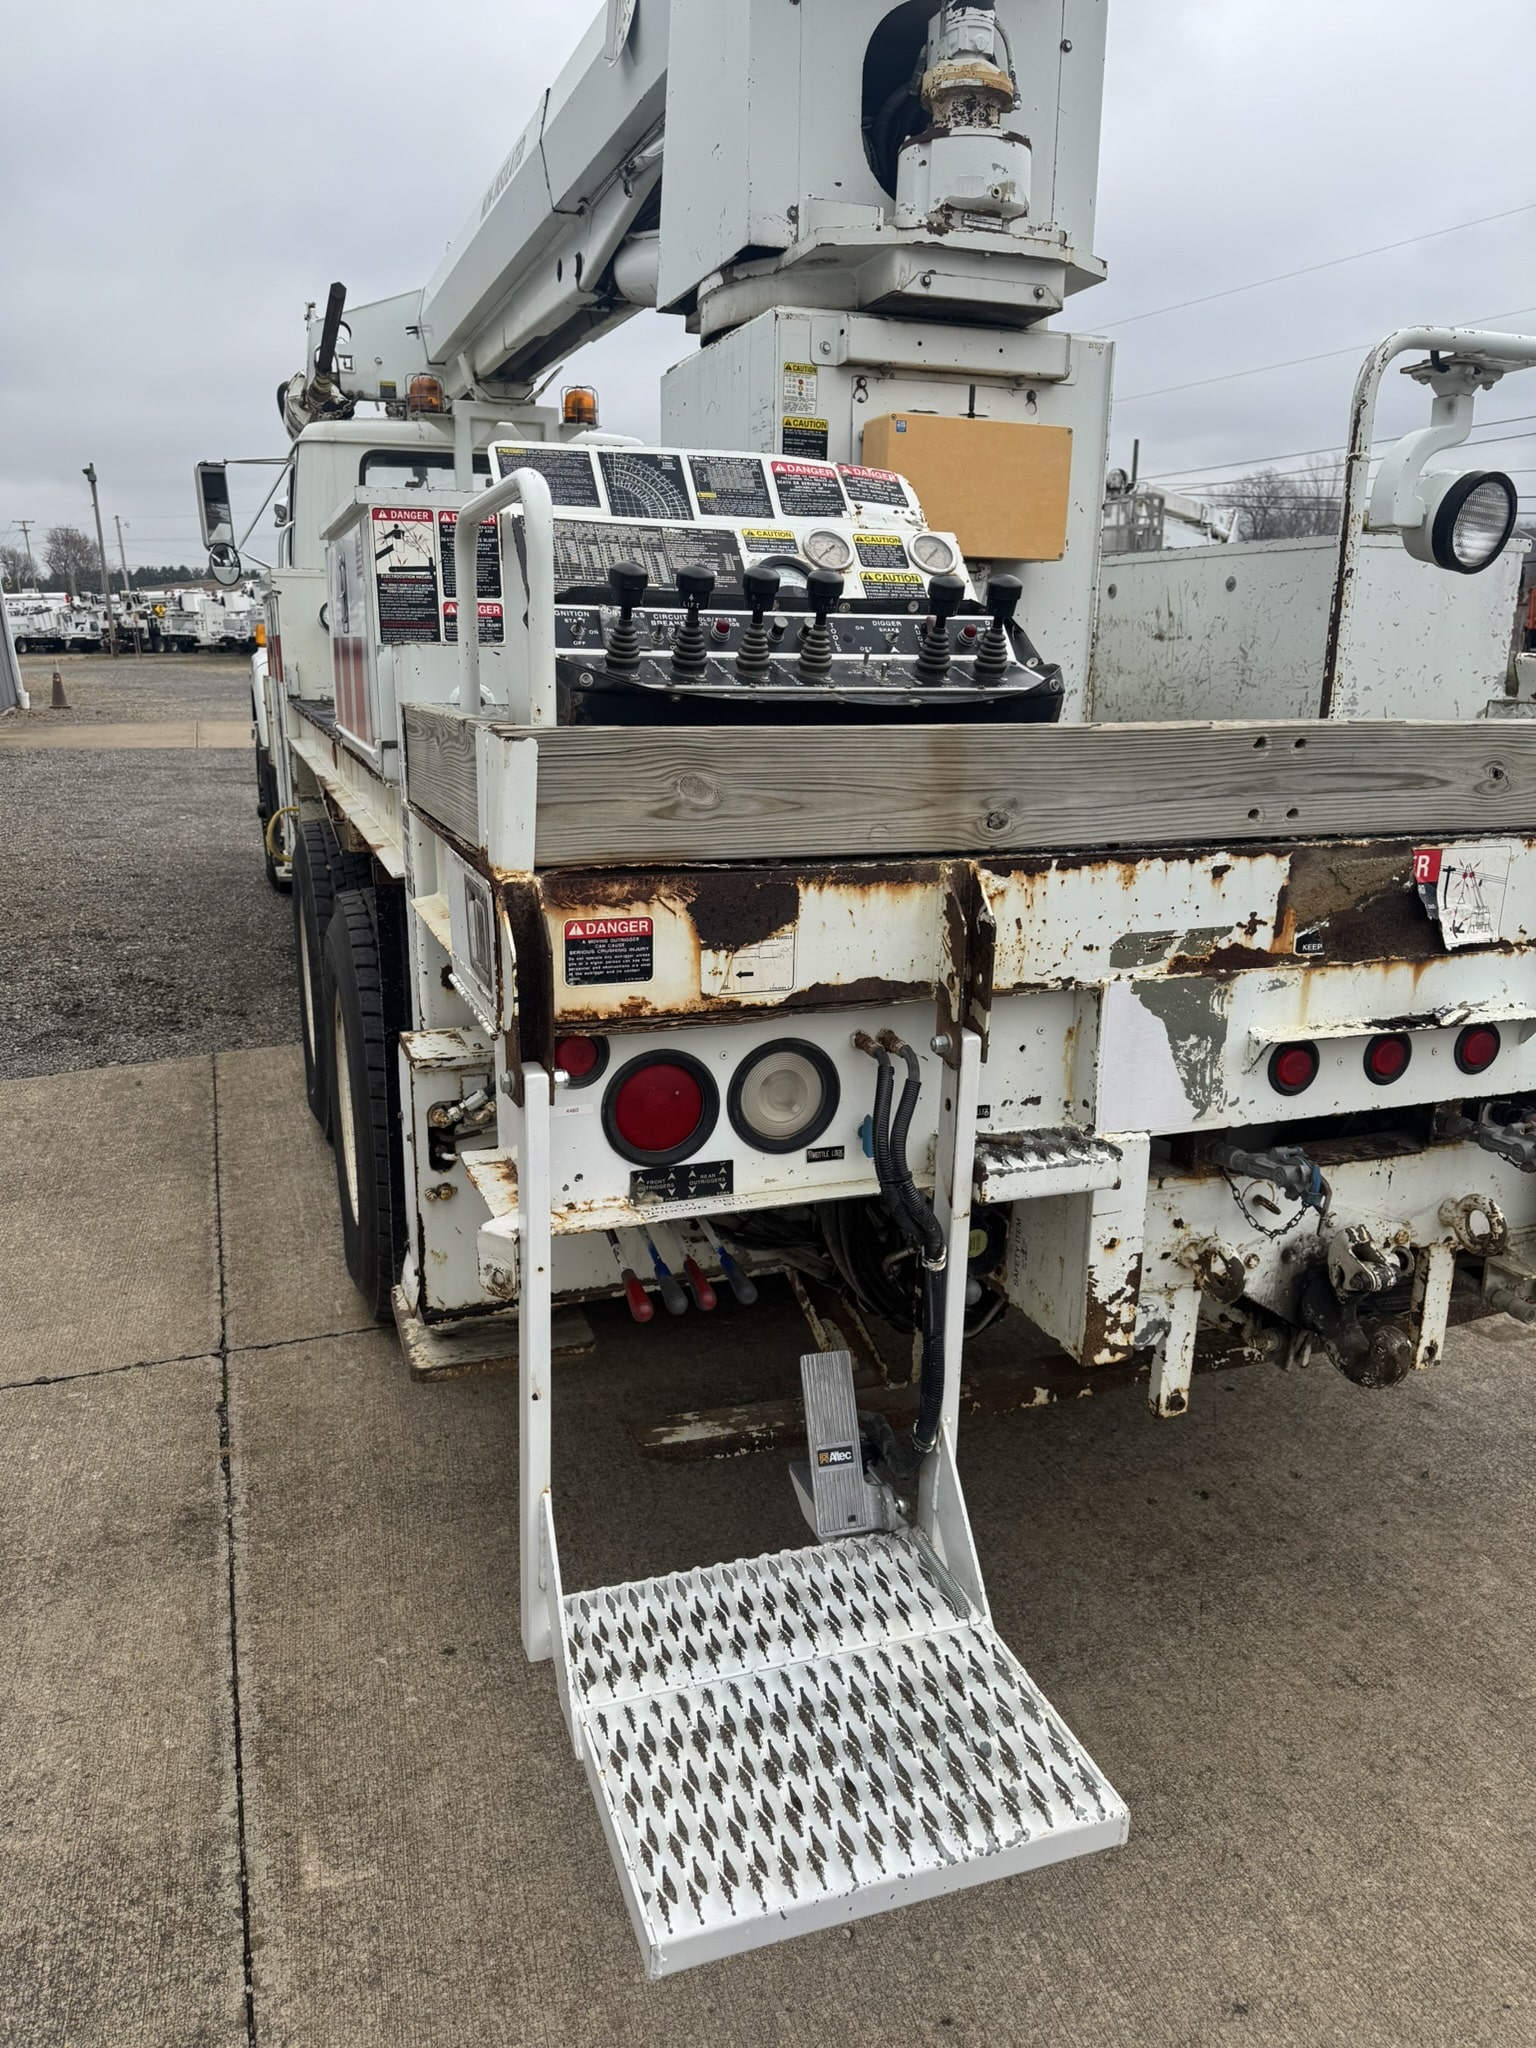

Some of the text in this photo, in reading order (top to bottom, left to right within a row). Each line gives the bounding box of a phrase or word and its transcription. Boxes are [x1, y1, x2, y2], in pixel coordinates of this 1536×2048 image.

[792, 419, 827, 429] CAUTION
[786, 464, 834, 476] DANGER
[852, 468, 897, 481] DANGER
[390, 512, 428, 520] DANGER
[756, 530, 792, 538] CAUTION
[864, 536, 901, 544] CAUTION
[874, 574, 919, 582] CAUTION
[478, 605, 500, 614] GER
[600, 606, 646, 618] CONTOLS
[829, 622, 842, 653] TOOLS
[586, 920, 649, 935] DANGER
[1302, 943, 1322, 951] KEEP
[808, 1150, 830, 1159] THROTTLE
[689, 1177, 726, 1185] OUTRIGGERS
[830, 1451, 852, 1462] Altec
